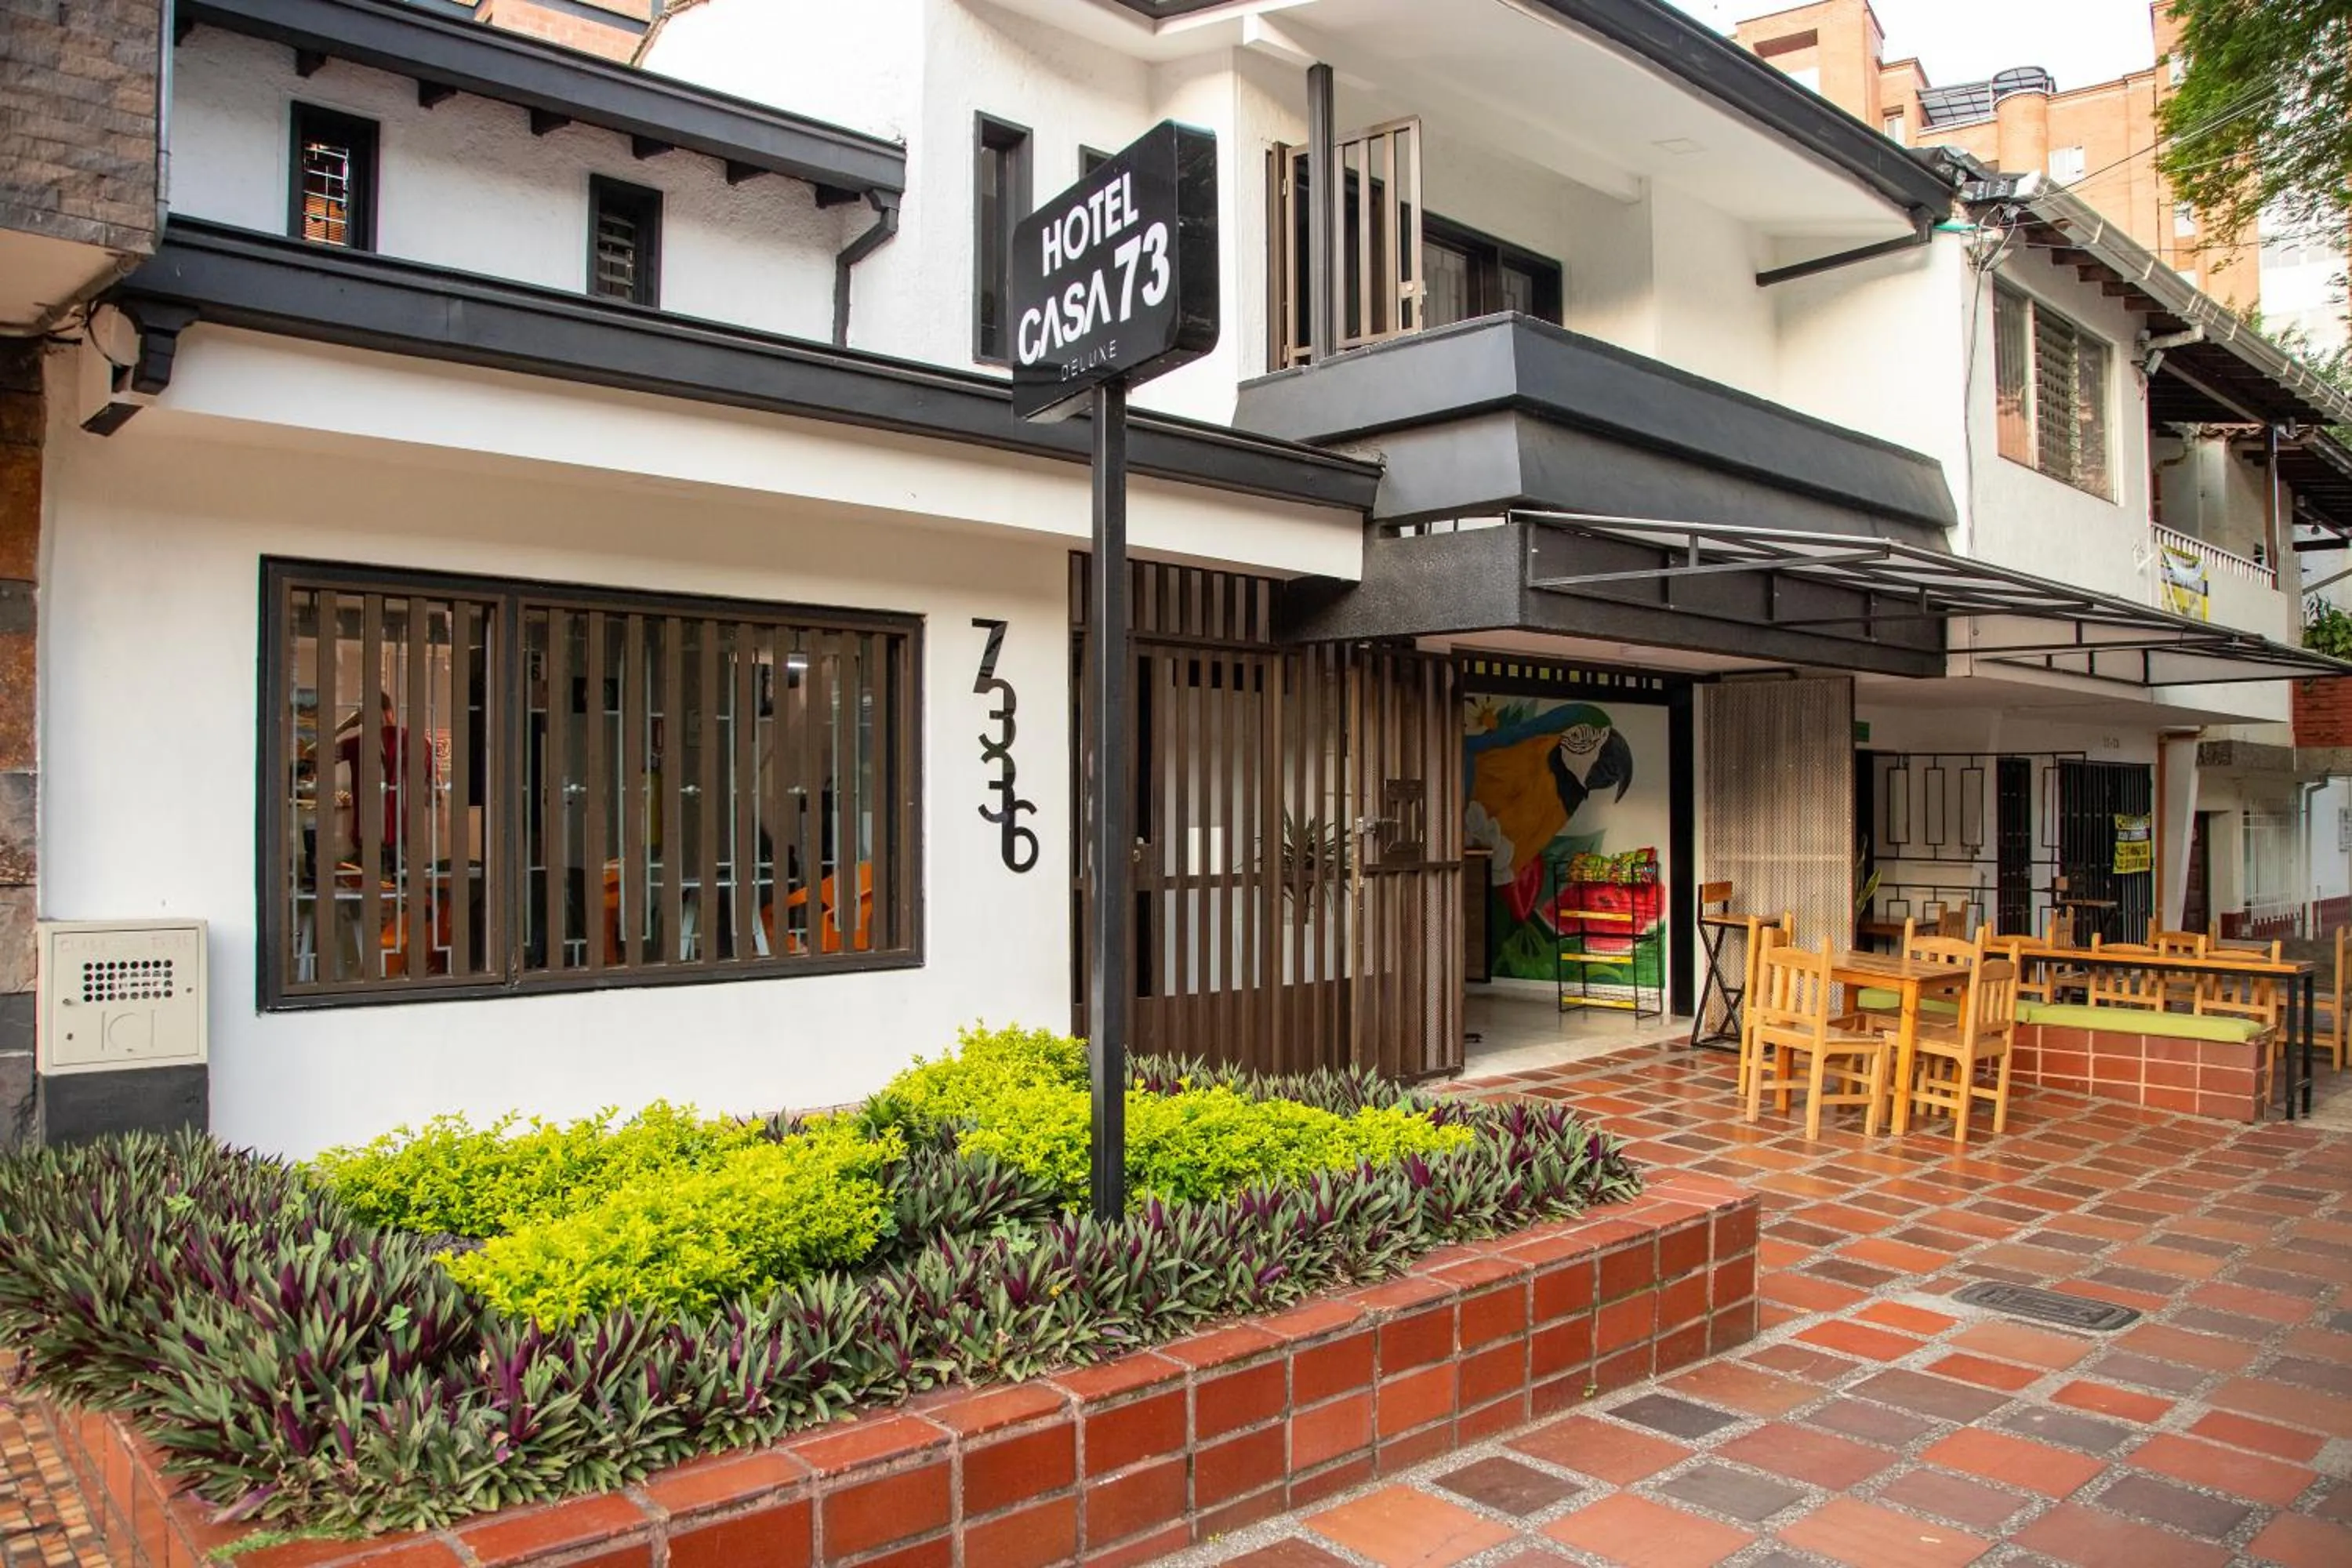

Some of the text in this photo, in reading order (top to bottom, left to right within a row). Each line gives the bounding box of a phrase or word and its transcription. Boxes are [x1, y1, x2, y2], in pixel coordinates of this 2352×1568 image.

[1042, 172, 1139, 277] HOTEL
[1114, 222, 1171, 322] 73
[1061, 339, 1116, 382] DELUXE
